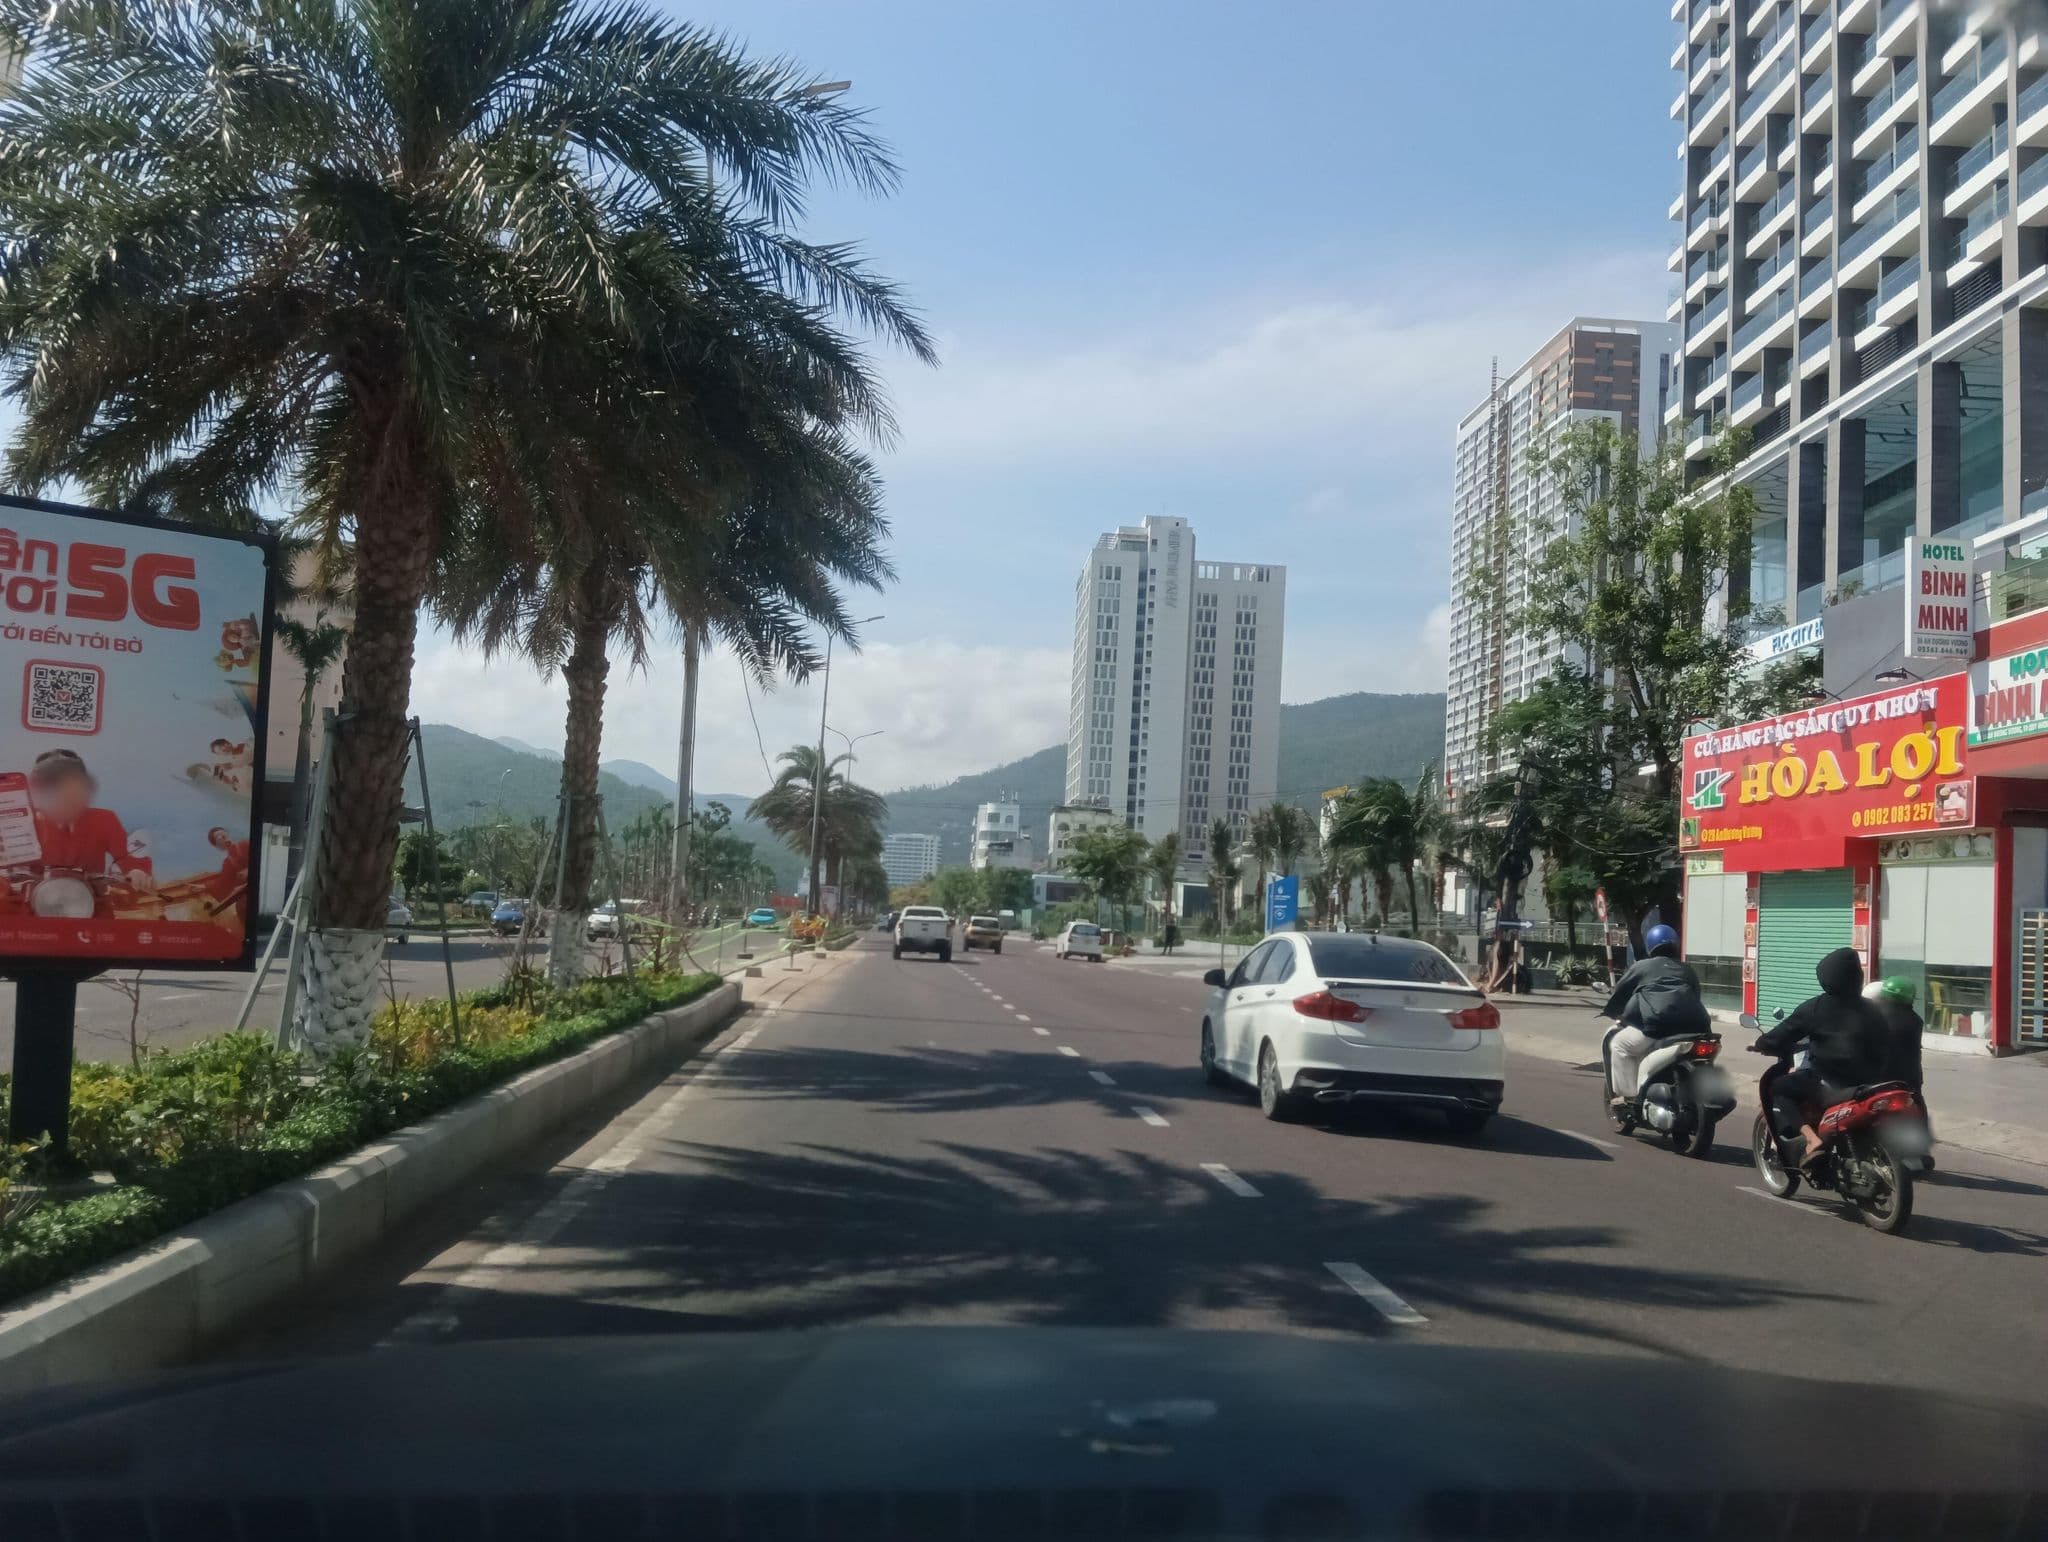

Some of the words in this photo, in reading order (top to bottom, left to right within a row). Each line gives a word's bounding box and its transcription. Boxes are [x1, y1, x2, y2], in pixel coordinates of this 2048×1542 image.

[1922, 544, 1965, 561] HOTEL
[0, 573, 58, 615] ơi
[65, 541, 201, 631] 5G
[1921, 565, 1966, 597] BÌNH
[1918, 604, 1968, 632] MINH
[29, 624, 72, 646] BẾN
[113, 635, 143, 654] BỜ
[1772, 633, 1790, 653] FLC
[1791, 623, 1813, 647] CITY
[1722, 727, 1764, 752] HÀNG
[1793, 708, 1831, 737] SẢN
[1830, 701, 1876, 734] QUY
[1875, 687, 1939, 721] NHƠN
[1738, 742, 1848, 805] HÒA
[1855, 721, 1964, 799] LỢI
[1863, 807, 1889, 827] 0902
[1891, 804, 1911, 824] 083
[1913, 801, 1935, 822] 257
